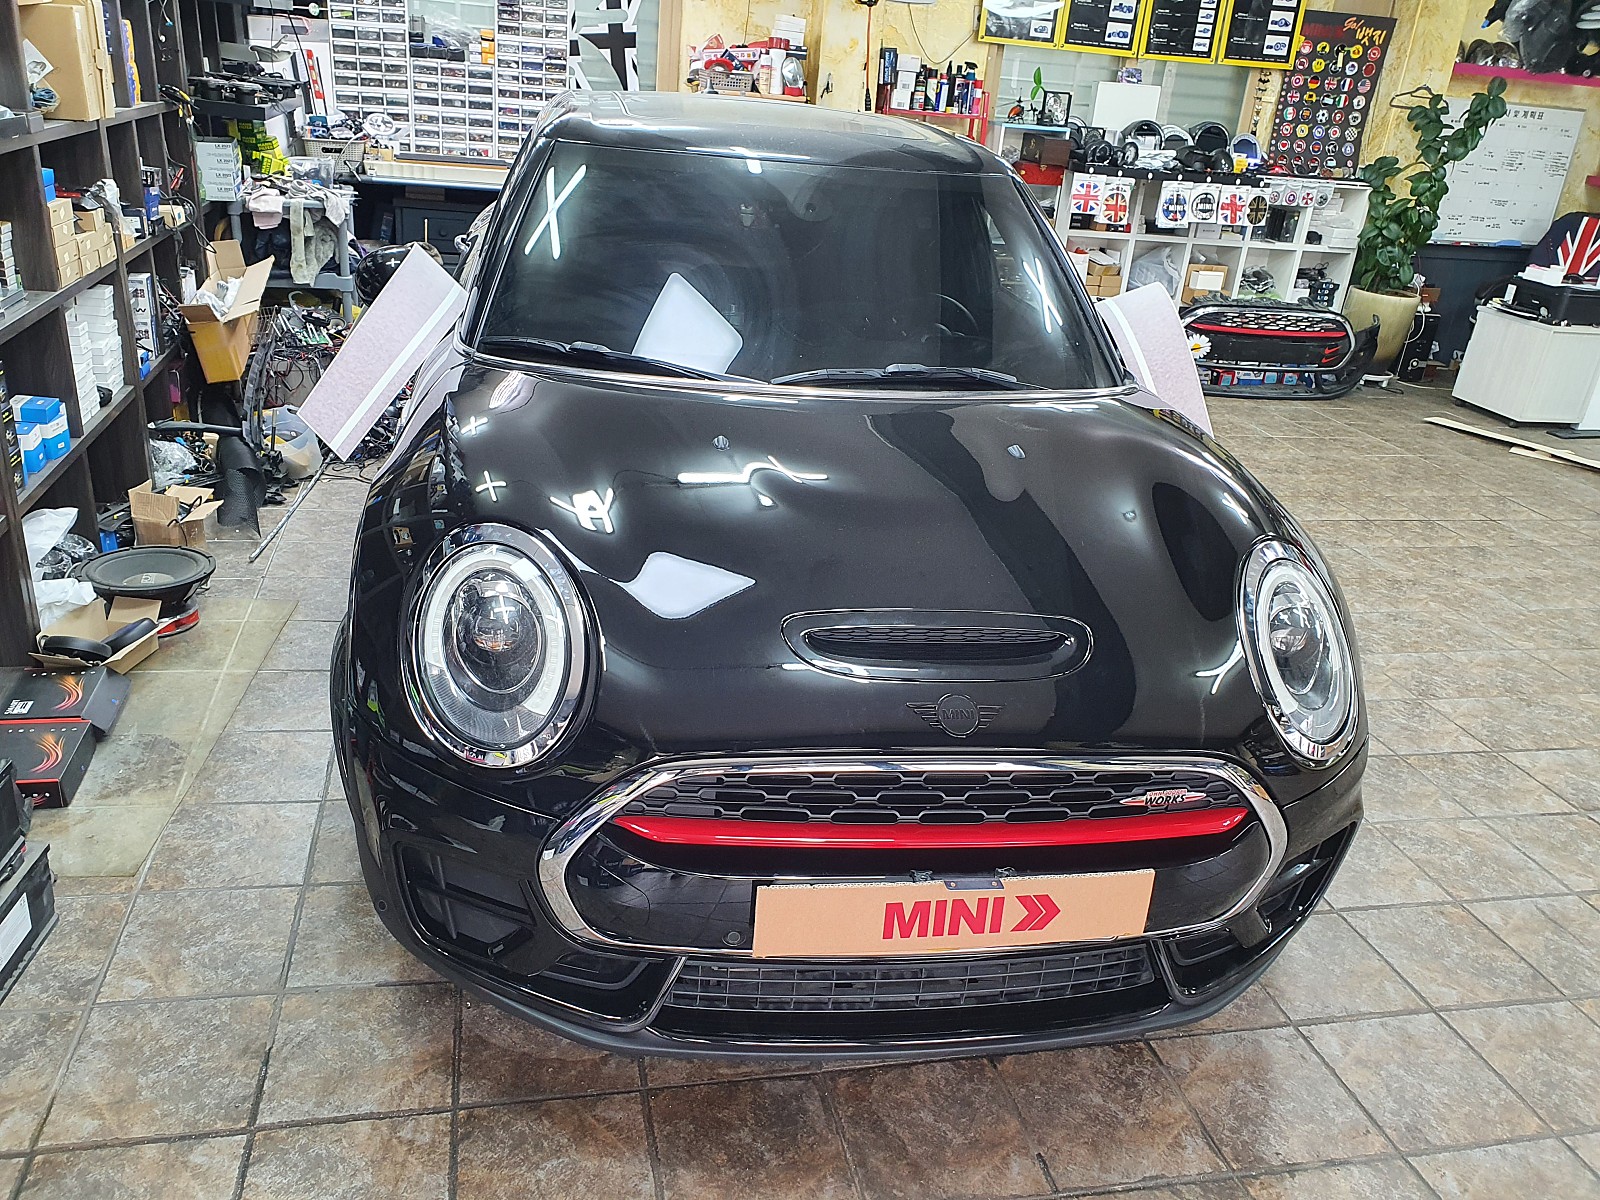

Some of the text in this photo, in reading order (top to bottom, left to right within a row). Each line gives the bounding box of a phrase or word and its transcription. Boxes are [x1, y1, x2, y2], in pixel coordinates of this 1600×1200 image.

[942, 708, 976, 720] MINI
[1144, 793, 1185, 806] WORKS
[882, 896, 1006, 940] MINI
